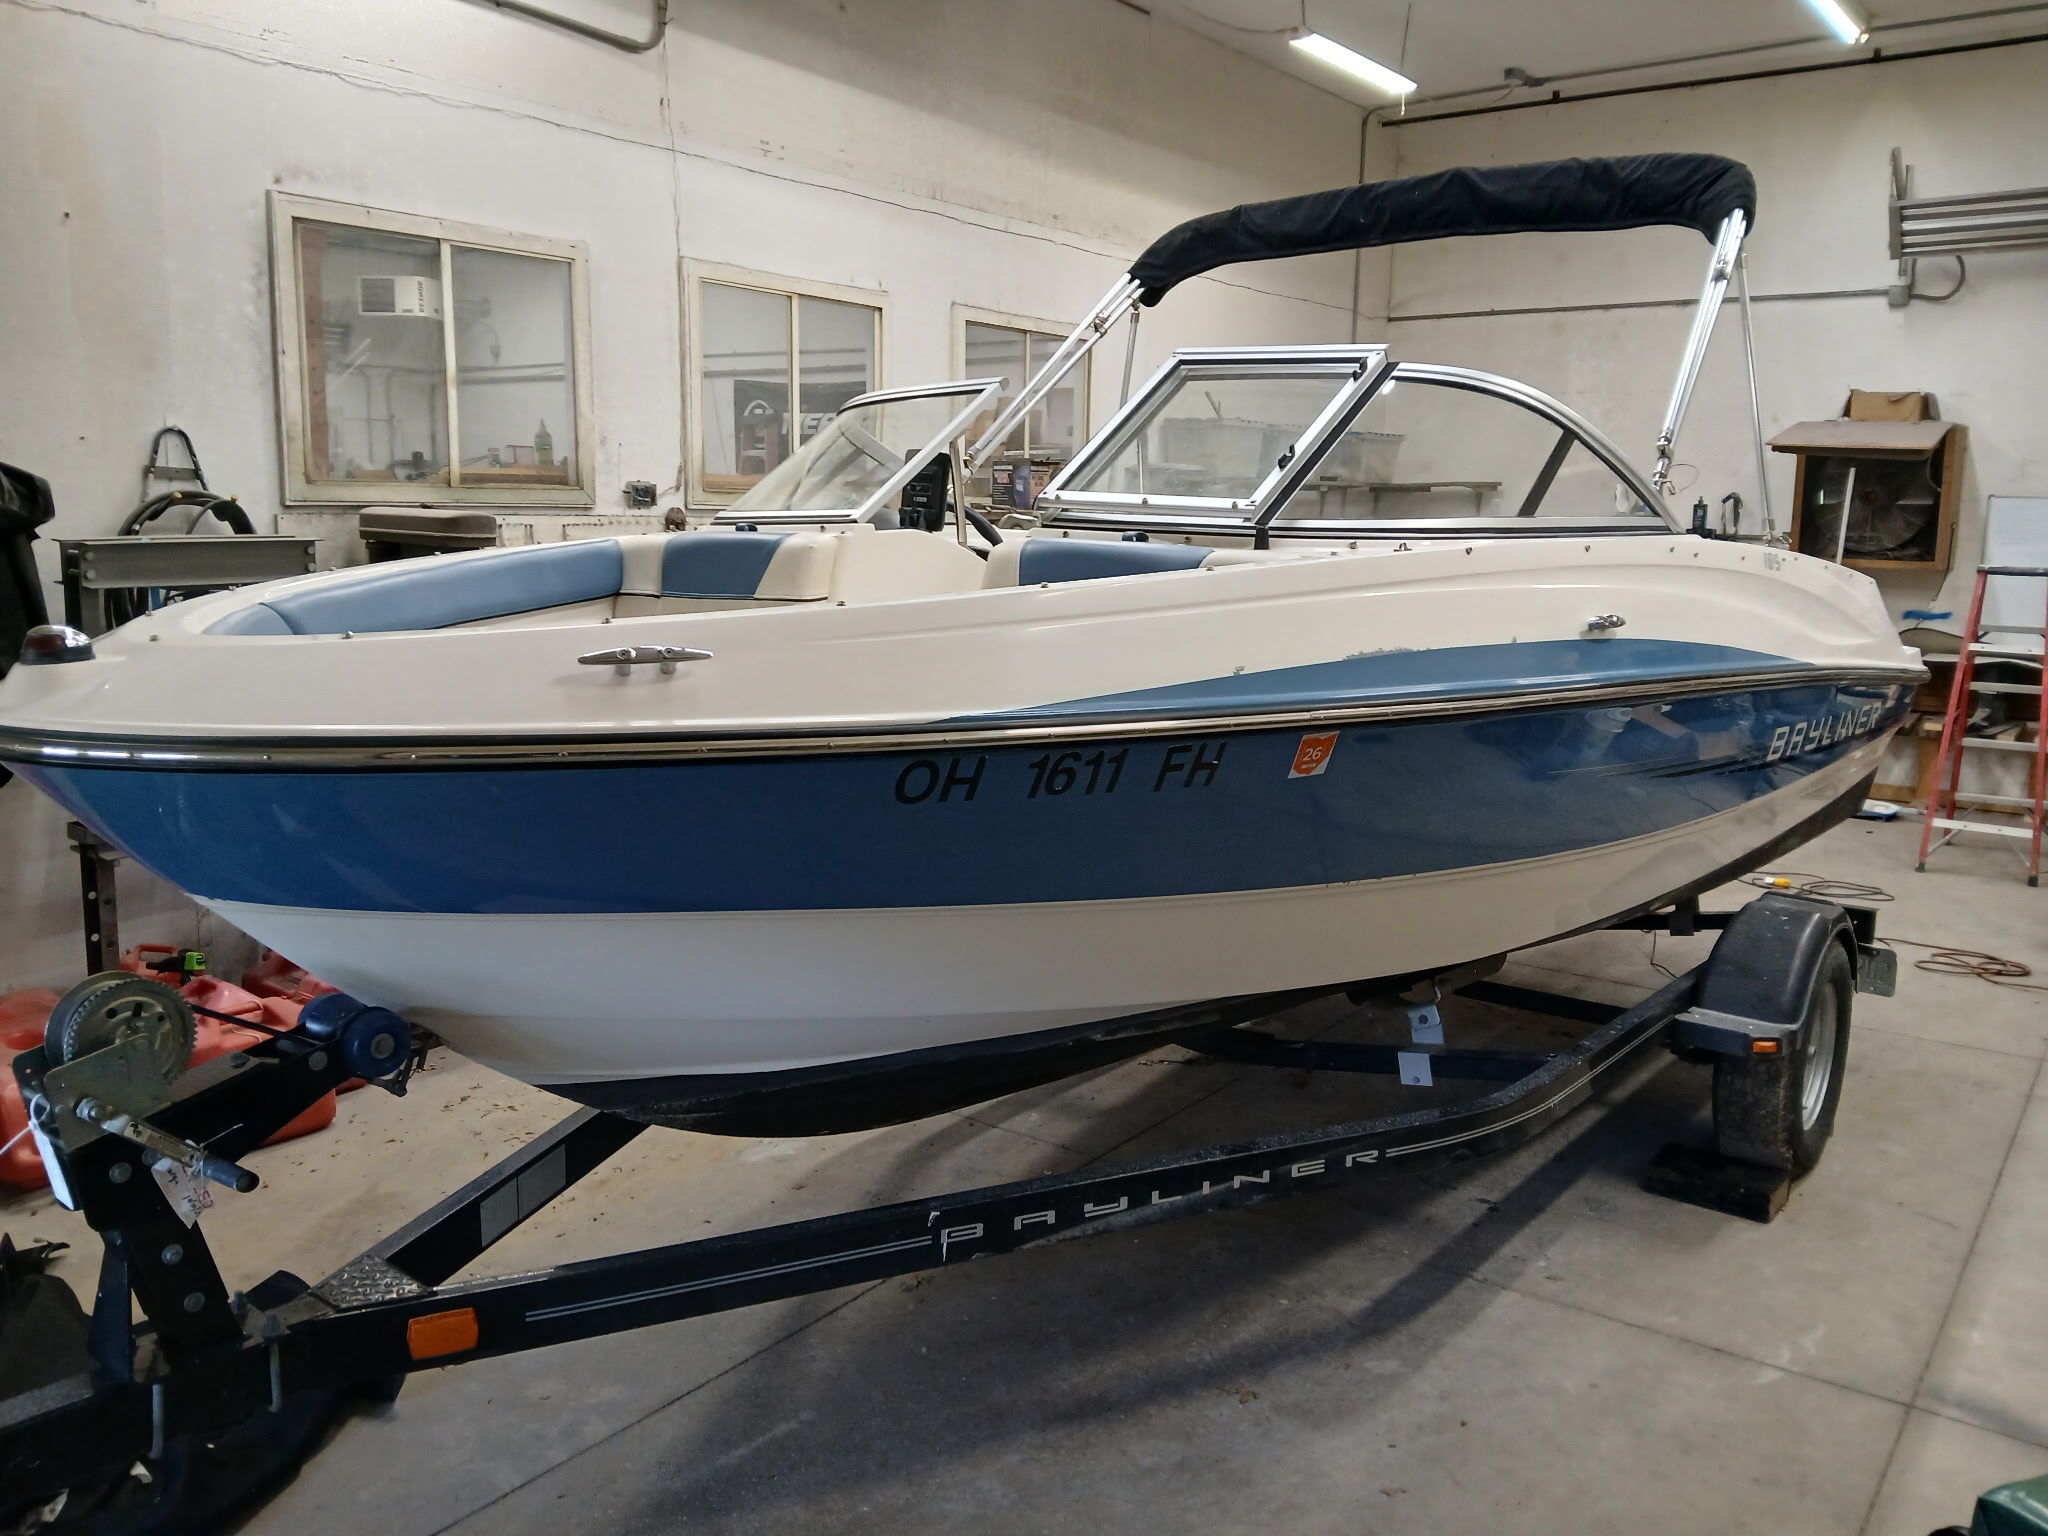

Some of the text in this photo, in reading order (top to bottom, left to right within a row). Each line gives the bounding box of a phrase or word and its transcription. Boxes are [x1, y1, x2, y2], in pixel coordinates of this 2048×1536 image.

[1302, 746, 1323, 761] 26
[1766, 701, 1883, 762] BAYLINER
[894, 741, 1229, 805] OH 1611 FH
[940, 1148, 1380, 1243] BAYLINER
